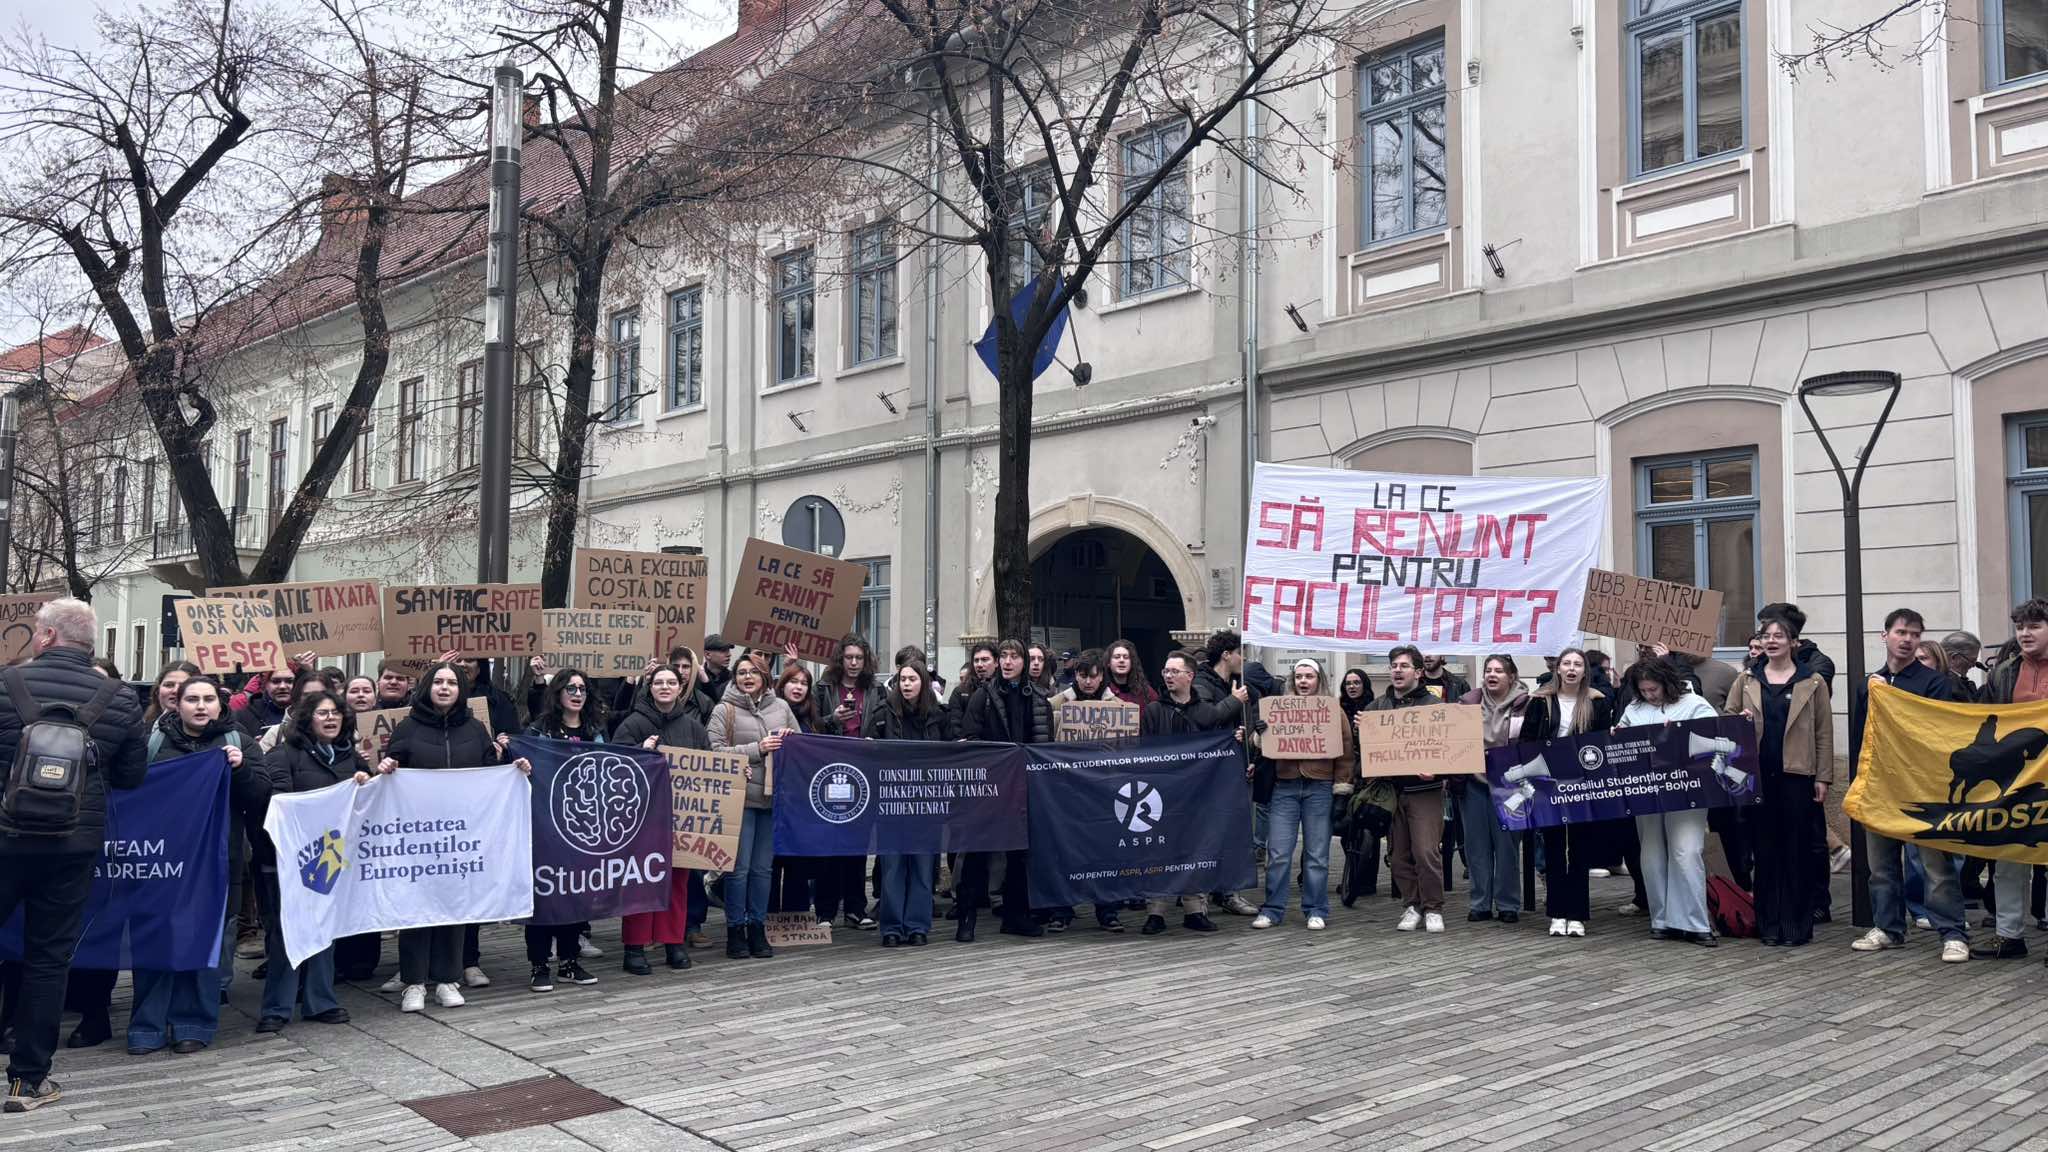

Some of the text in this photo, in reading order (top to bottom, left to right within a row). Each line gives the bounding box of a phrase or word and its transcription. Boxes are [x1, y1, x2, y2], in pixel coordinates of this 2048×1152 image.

[1373, 482, 1456, 513] LA CE
[1256, 495, 1325, 551] SĂ
[589, 555, 633, 574] DACĂ
[757, 556, 835, 589] LA CE SĂ
[1332, 553, 1481, 588] PENTRU
[312, 582, 378, 612] TAXATĂ
[453, 589, 488, 612] FAC
[491, 589, 541, 612] RATE
[654, 580, 673, 599] DE
[677, 582, 695, 599] CE
[1589, 571, 1703, 610] UBB PENTRU
[187, 601, 274, 619] OARE CÂND
[544, 612, 602, 628] TAXELE
[657, 605, 696, 624] DOAR
[770, 606, 821, 630] PENTRU
[1242, 575, 1559, 644] FACULTATE?
[1664, 607, 1692, 627] NU
[192, 621, 203, 634] O
[207, 619, 229, 634] SĂ
[437, 613, 511, 635] PENTRU
[1229, 619, 1235, 627] 4
[1583, 612, 1711, 653] PENTRU PROFIT
[408, 632, 537, 654] FACULTATE?
[618, 633, 633, 645] LA
[744, 620, 838, 657] FACULTAT
[195, 640, 278, 671] PESE?
[1380, 714, 1394, 726] LA
[1402, 711, 1420, 724] CE
[1133, 754, 1179, 764] PSIHOLOGI
[1181, 752, 1196, 760] DIN
[879, 768, 925, 781] CONSILIUL
[1557, 769, 1689, 793] Consiliul Studenților din
[959, 782, 999, 797] TANÁCSA
[1550, 780, 1702, 805] Universitatea Babeș-Bolyai
[673, 792, 720, 814] INALE
[879, 801, 951, 815] STUDENTENRAT
[359, 818, 466, 838] Societatea
[1936, 801, 2048, 833] KMDSZ
[357, 837, 481, 860] Studenților
[107, 861, 184, 879] DREAM
[359, 856, 485, 882] Europeniști
[534, 852, 667, 897] StudPAC
[1086, 870, 1118, 879] PENTRU
[1165, 862, 1196, 872] PENTRU
